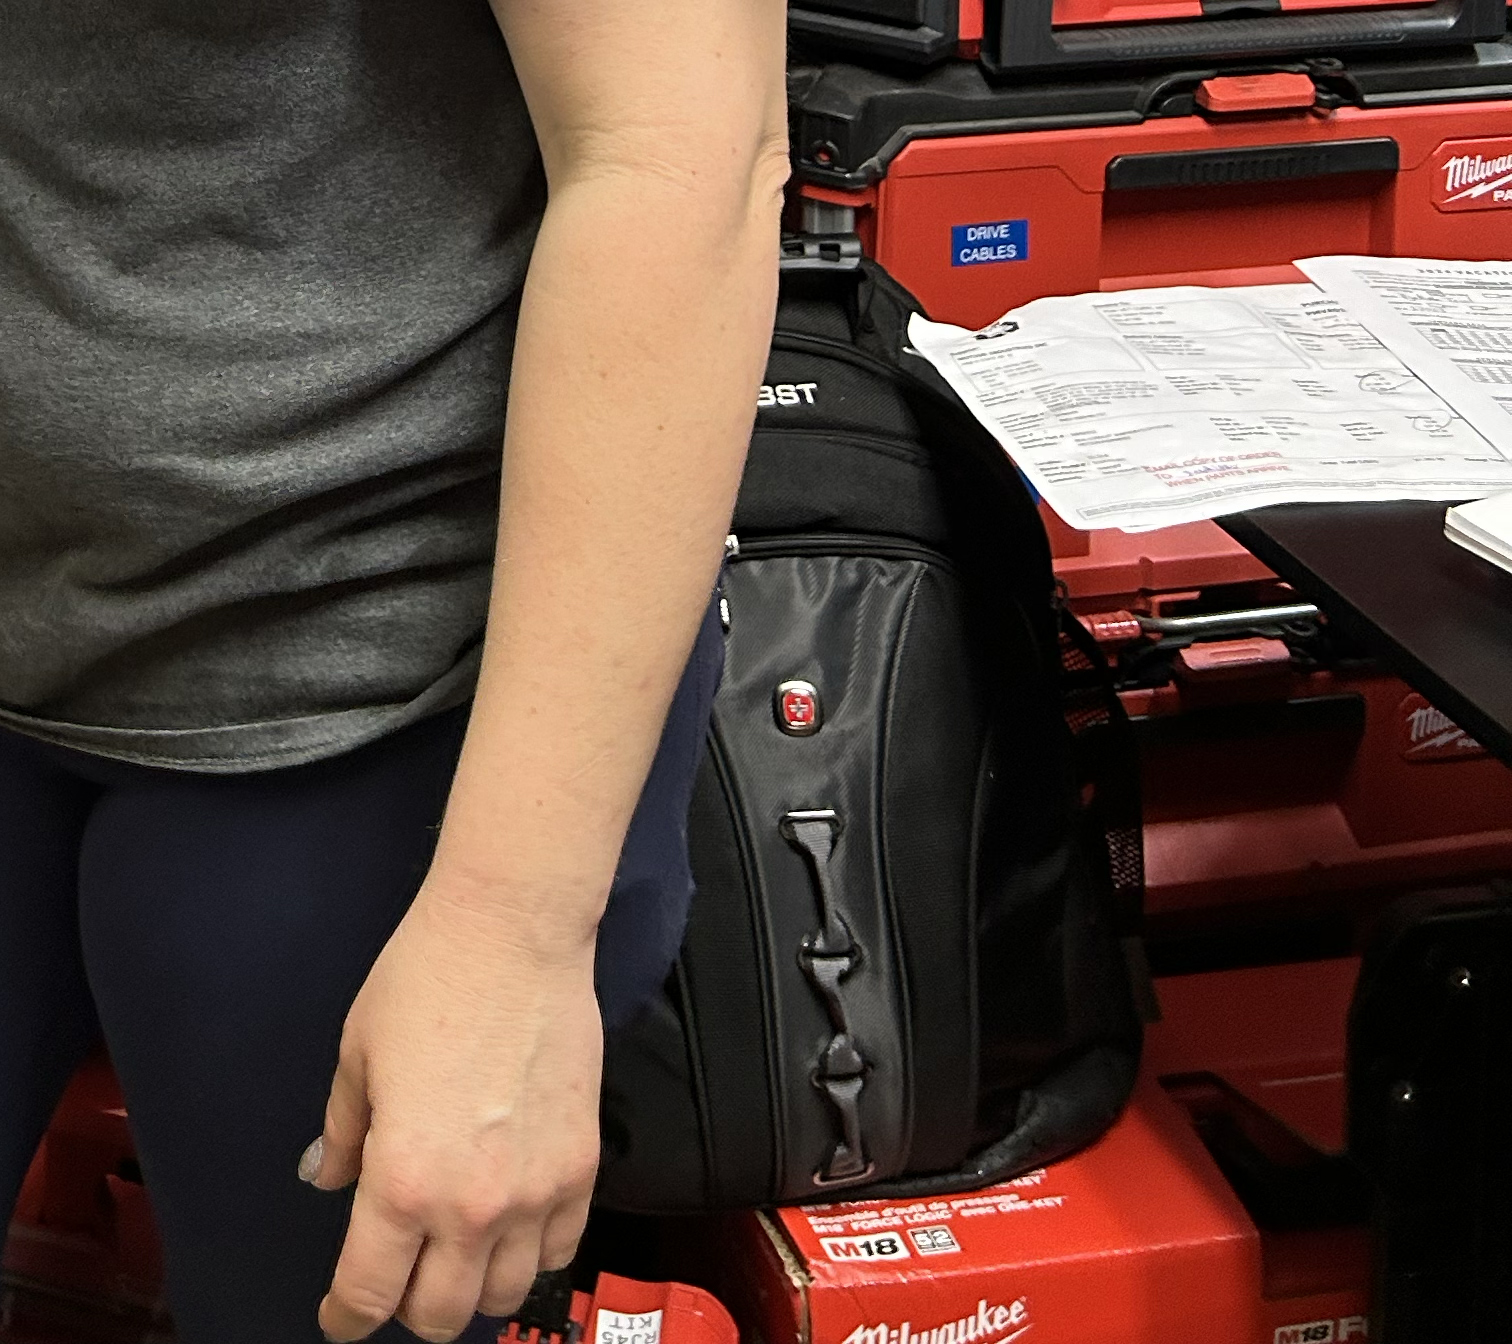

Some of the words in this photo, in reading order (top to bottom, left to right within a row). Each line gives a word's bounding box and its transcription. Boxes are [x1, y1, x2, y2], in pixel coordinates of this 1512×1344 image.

[967, 224, 1010, 243] DRIVE
[959, 243, 1017, 263] CABLES
[808, 1210, 879, 1224] Ensemble
[929, 1201, 949, 1211] de
[950, 1193, 1020, 1210] pressage
[851, 1216, 904, 1231] FORCE
[905, 1210, 952, 1224] LOGIC
[998, 1196, 1064, 1211] ONE-KEY
[829, 1238, 898, 1257] M18
[609, 1315, 652, 1330] KIT
